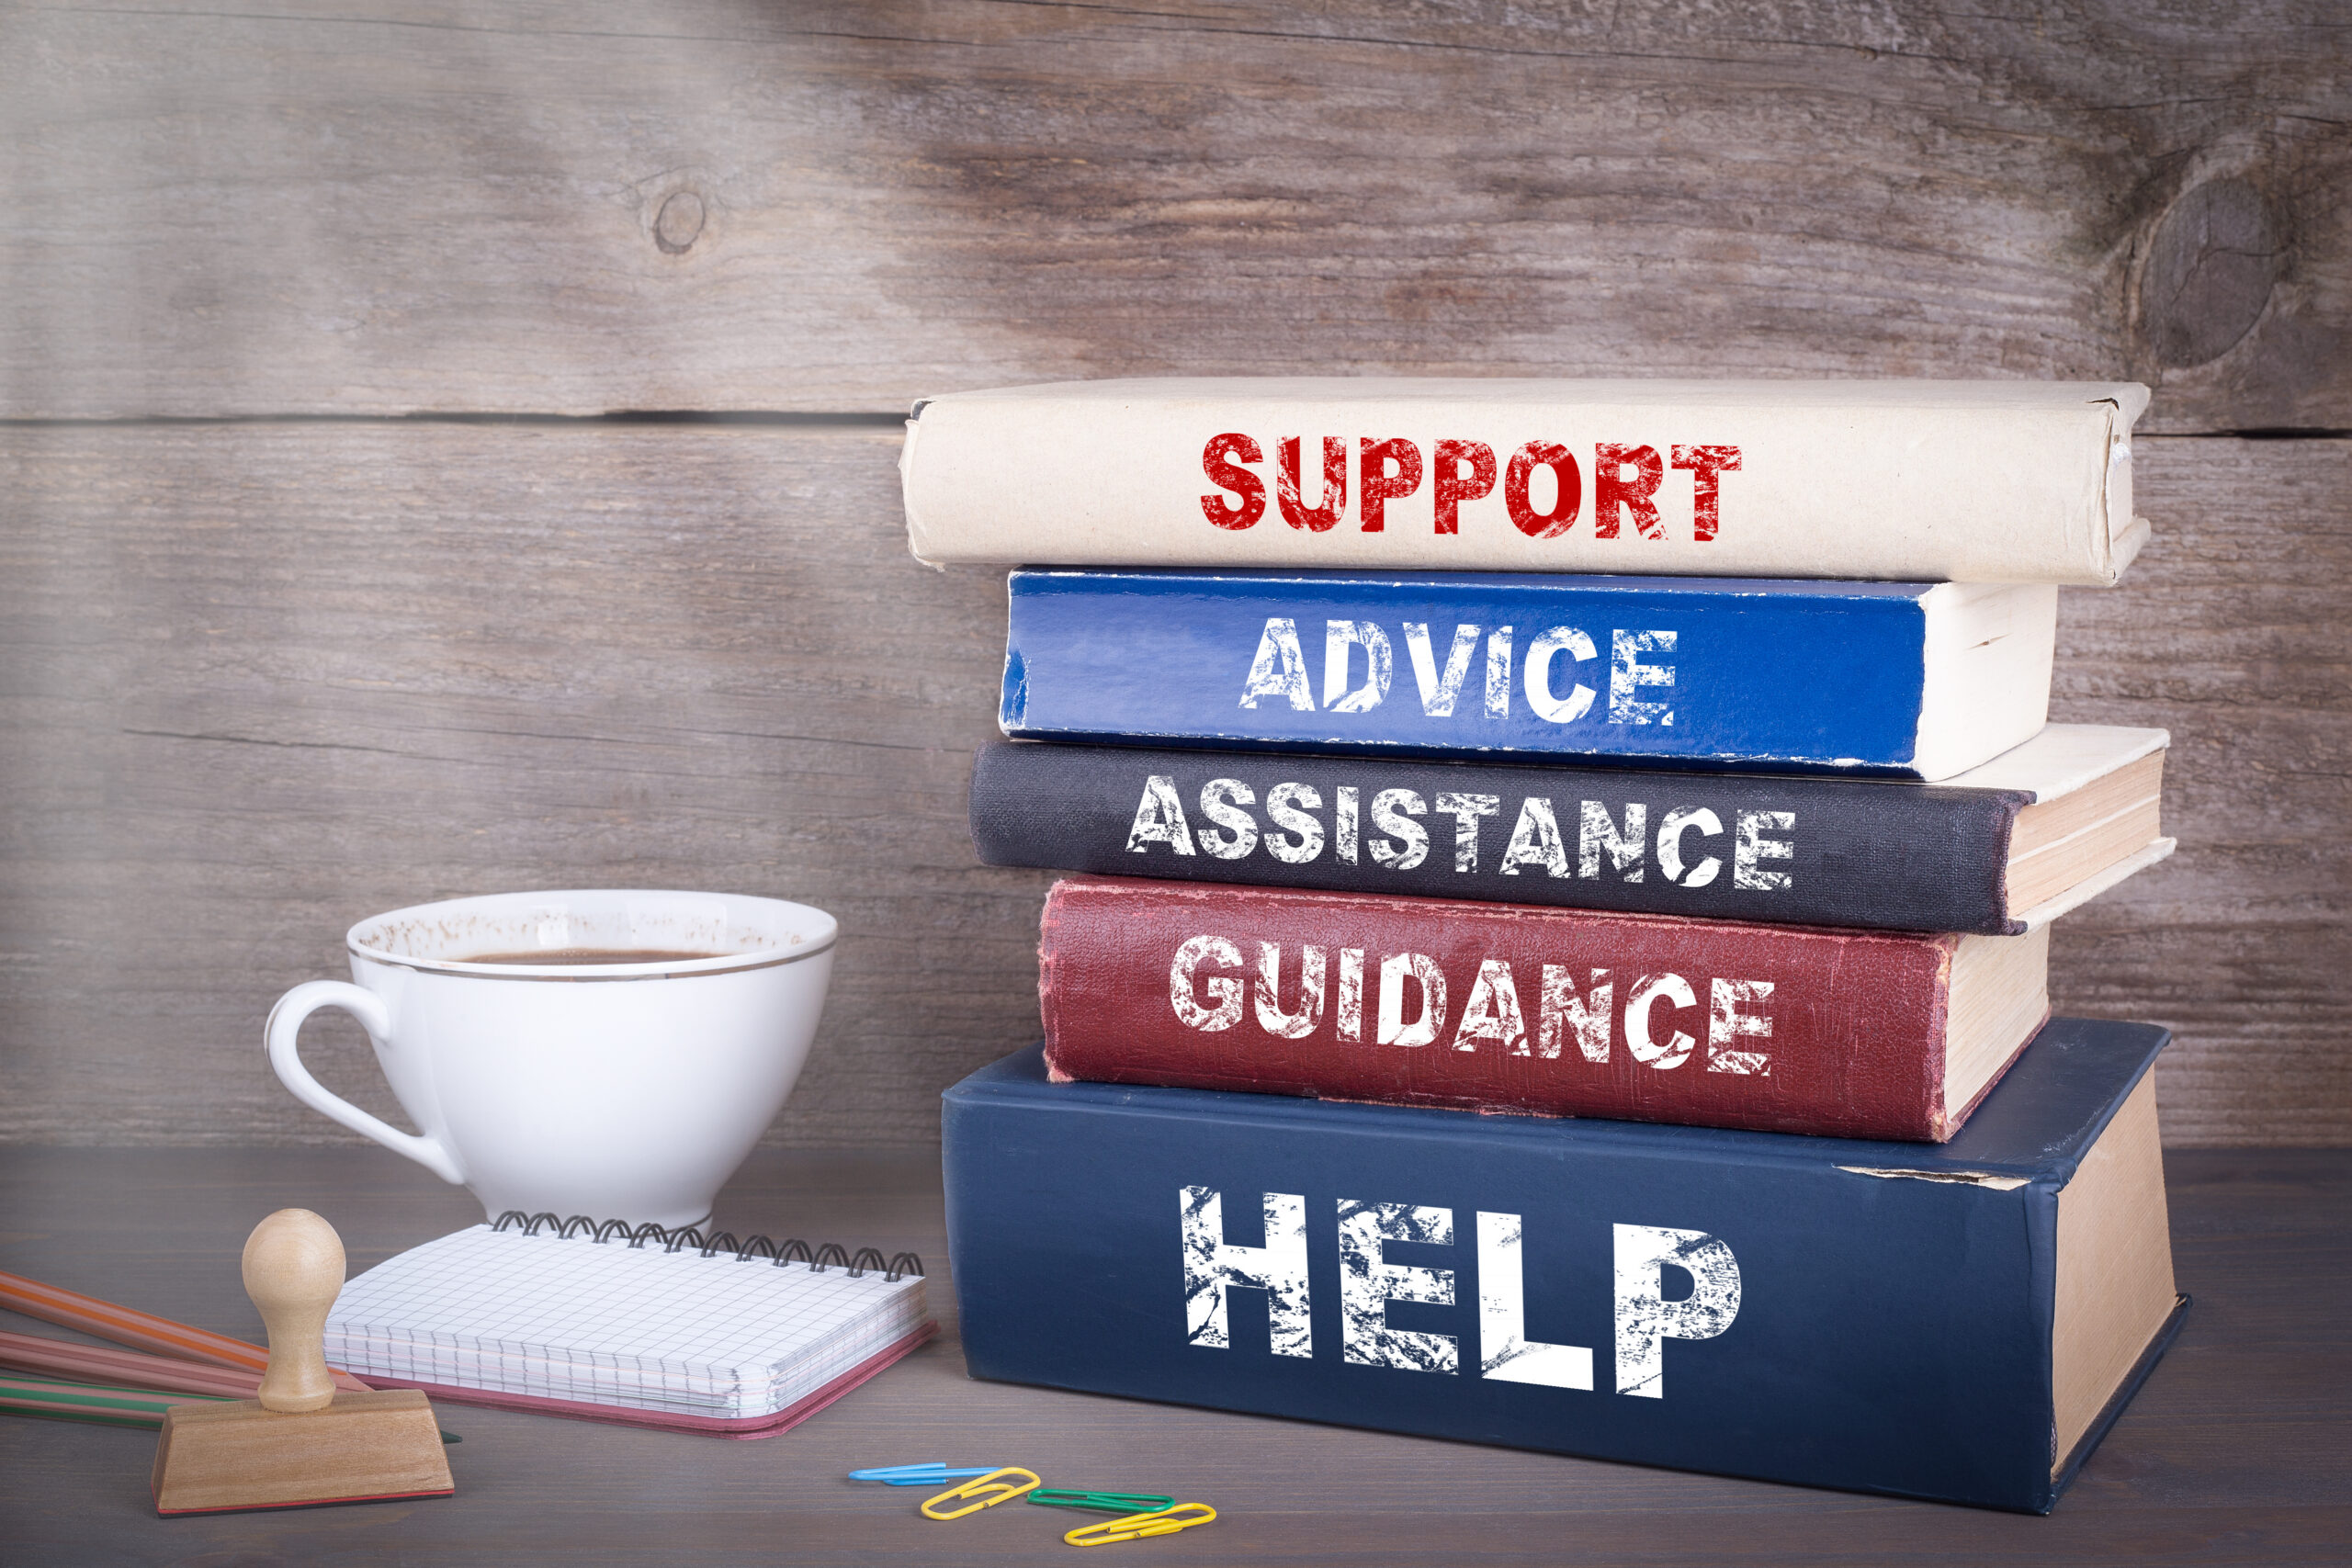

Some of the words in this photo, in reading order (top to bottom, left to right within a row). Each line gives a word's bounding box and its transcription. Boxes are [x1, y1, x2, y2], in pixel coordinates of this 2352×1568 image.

[1201, 433, 1741, 542] SUPPORT
[1238, 617, 1678, 728] ADVICE
[1125, 774, 1796, 893] ASSISTANCE
[1169, 935, 1775, 1078] GUIDANCE
[1180, 1185, 1742, 1400] HELP
